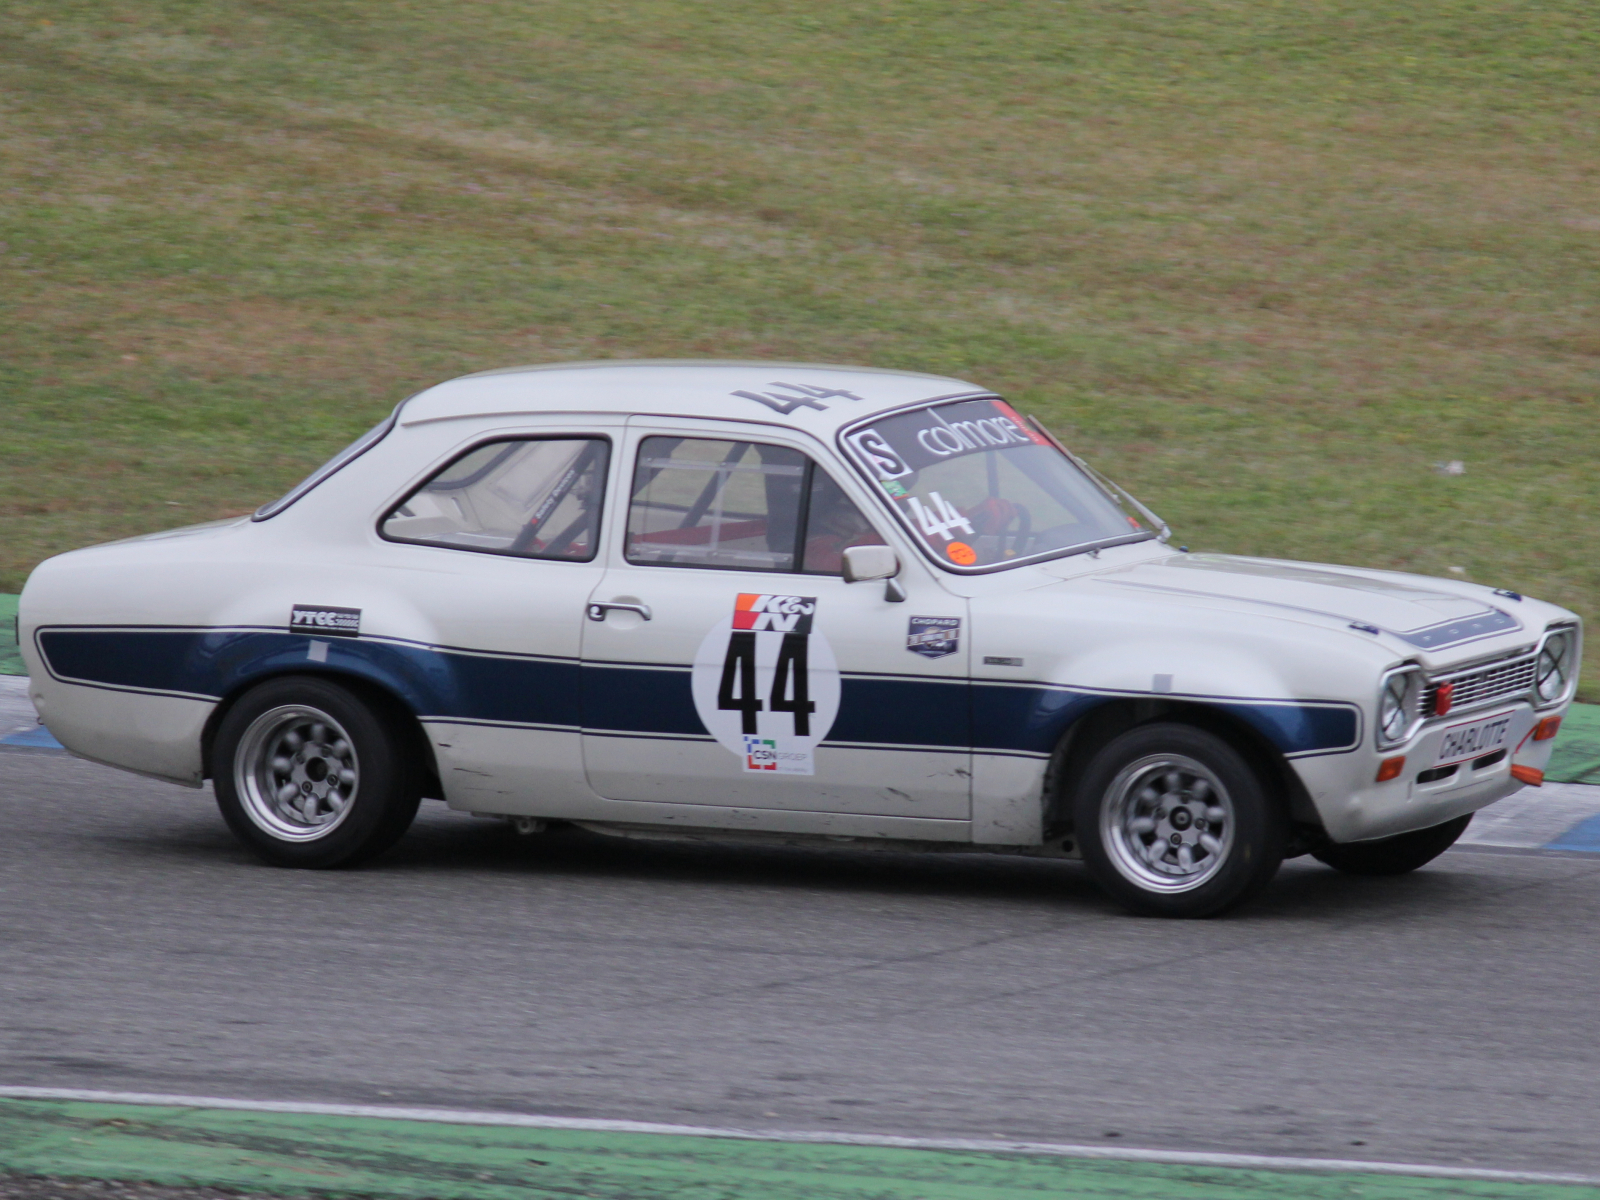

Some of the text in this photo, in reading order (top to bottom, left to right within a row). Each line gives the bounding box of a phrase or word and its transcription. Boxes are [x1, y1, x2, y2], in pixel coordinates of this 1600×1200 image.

[728, 381, 865, 415] 44
[917, 407, 1030, 456] colmore
[858, 432, 905, 475] S
[907, 491, 976, 541] 44
[292, 610, 337, 626] YTCC
[717, 631, 816, 736] 44
[1440, 718, 1510, 759] CHARLOTTE
